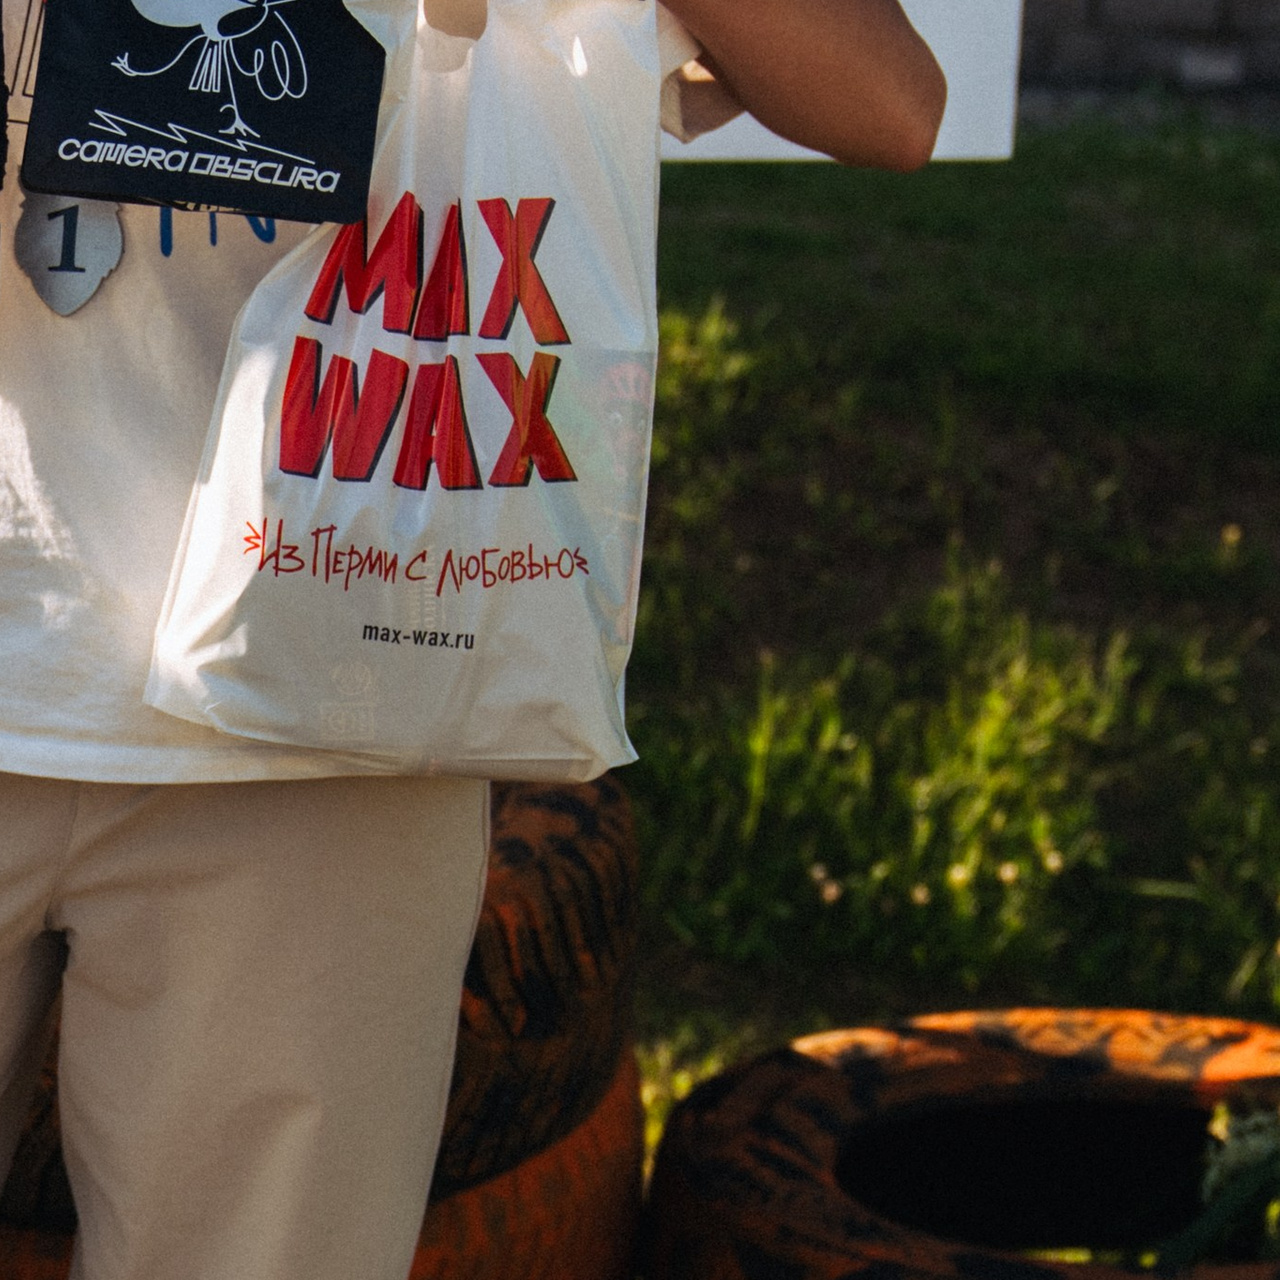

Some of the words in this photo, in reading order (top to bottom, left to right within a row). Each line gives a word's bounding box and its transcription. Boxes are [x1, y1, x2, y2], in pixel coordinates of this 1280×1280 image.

[47, 205, 86, 273] 1
[304, 190, 573, 347] MAX
[278, 335, 580, 491] WAX
[362, 621, 476, 651] max-wax.ru
